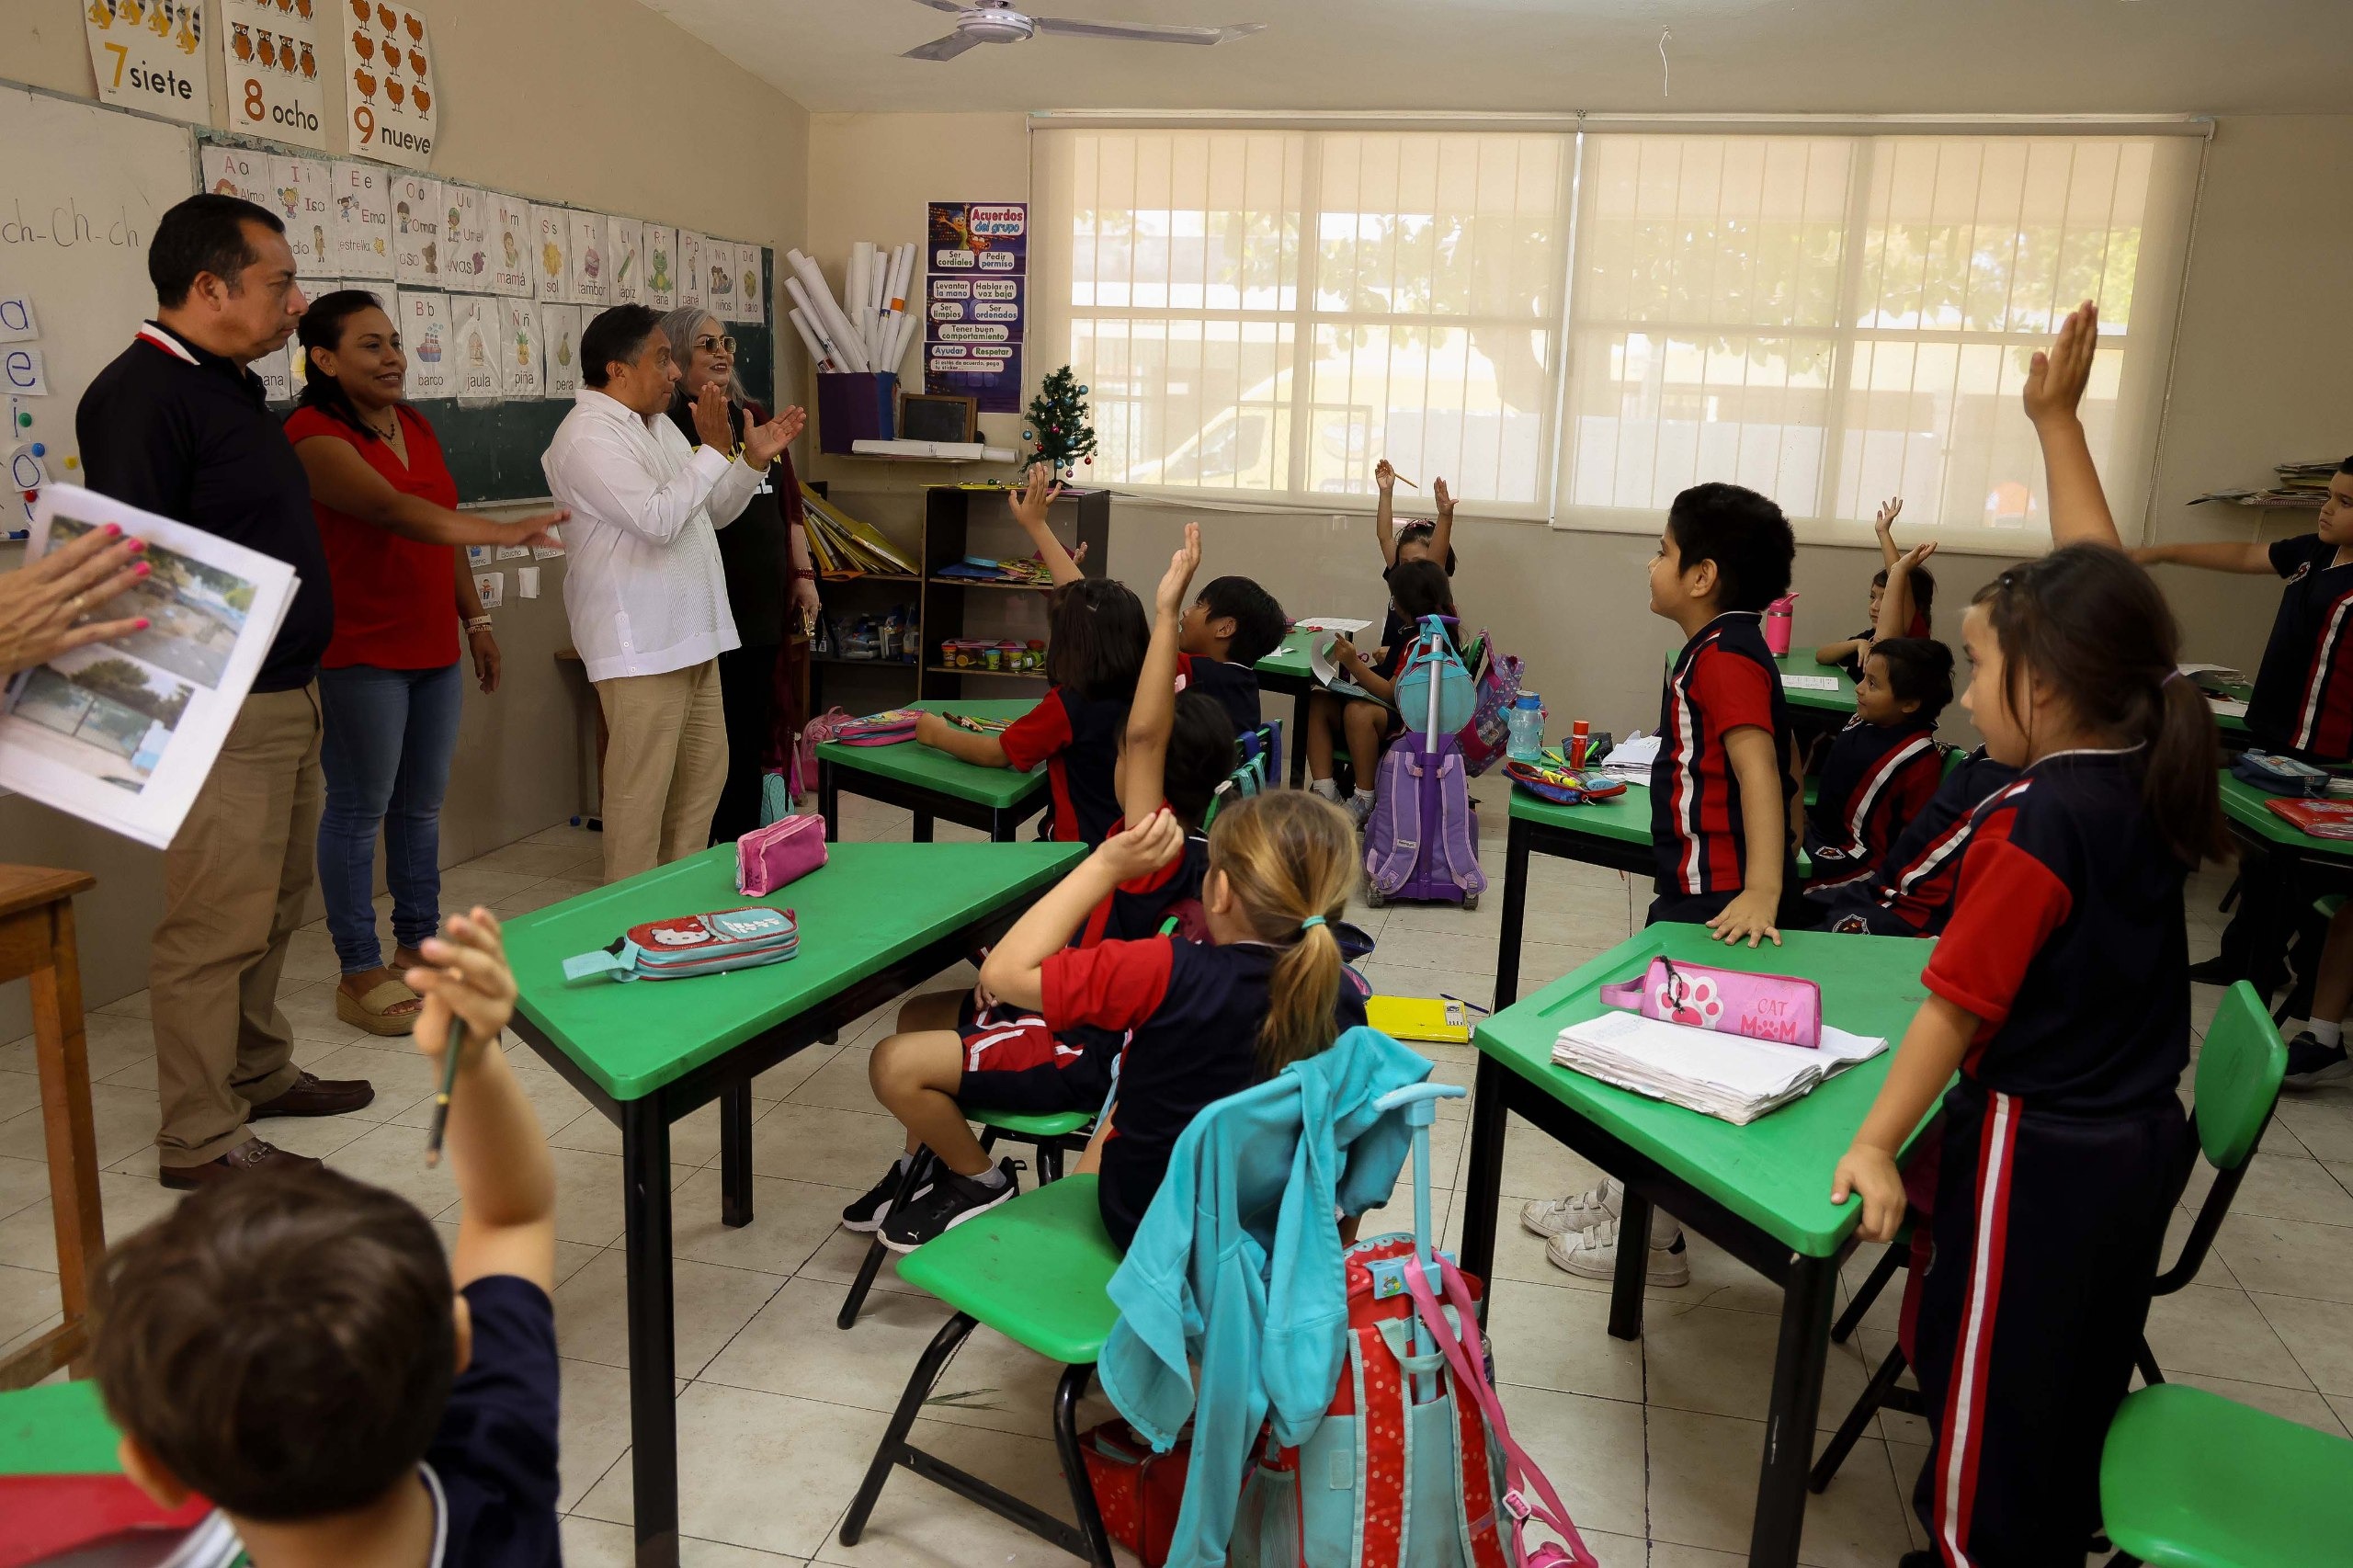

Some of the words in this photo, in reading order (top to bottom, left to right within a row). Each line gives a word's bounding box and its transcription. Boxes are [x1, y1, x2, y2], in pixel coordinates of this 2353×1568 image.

[105, 41, 128, 87] 7
[130, 61, 192, 99] siete
[244, 79, 266, 121] 8
[273, 99, 318, 131] ocho
[354, 106, 374, 144] 9
[381, 126, 431, 154] nueve
[224, 156, 236, 175] A
[239, 162, 250, 176] a
[290, 166, 300, 183] I
[306, 167, 311, 183] i
[351, 171, 360, 187] E
[364, 176, 372, 188] e
[240, 187, 265, 202] Alma
[406, 182, 415, 199] O
[418, 188, 425, 200] o
[305, 198, 325, 212] Isa
[456, 191, 464, 208] U
[361, 210, 386, 225] Ema
[499, 209, 507, 222] M
[510, 213, 519, 227] m
[972, 209, 1023, 222] Acuerdos
[412, 219, 438, 234] Omar
[542, 220, 550, 233] S
[551, 224, 558, 235] s
[583, 224, 590, 238] T
[591, 226, 596, 239] t
[974, 221, 990, 233] del
[991, 224, 1020, 234] grupo
[339, 236, 370, 253] estrella
[654, 231, 661, 244] R
[662, 235, 666, 244] r
[685, 236, 692, 250] P
[694, 242, 699, 256] p
[399, 253, 420, 267] oso
[714, 248, 721, 261] N
[722, 252, 726, 262] n
[743, 250, 748, 262] D
[749, 251, 754, 263] d
[949, 250, 961, 258] Ser
[938, 258, 972, 267] cordiales
[982, 260, 1013, 268] permiso
[497, 272, 526, 287] mamá
[546, 279, 560, 293] sol
[975, 282, 1003, 290] Hablar
[577, 280, 606, 296] tambor
[619, 285, 636, 301] lápiz
[995, 290, 1013, 300] baja
[654, 294, 669, 305] rana
[0, 300, 28, 331] a
[415, 301, 424, 315] B
[427, 301, 435, 317] b
[468, 302, 474, 317] J
[476, 302, 481, 322] j
[933, 310, 961, 319] limpios
[975, 311, 1017, 319] ordenados
[989, 304, 1002, 312] Ser
[512, 309, 520, 326] Ñ
[523, 312, 530, 327] ñ
[951, 324, 973, 333] Tener
[974, 324, 995, 333] buen
[941, 332, 1005, 341] comportamiento
[935, 347, 963, 356] Ayudar
[975, 347, 1009, 357] Respetar
[6, 351, 36, 387] e
[417, 373, 444, 386] barco
[466, 372, 491, 392] jaula
[515, 370, 534, 388] piña
[556, 380, 574, 393] pera
[12, 397, 18, 437] i
[13, 454, 40, 488] o
[1757, 998, 1789, 1017] CAT
